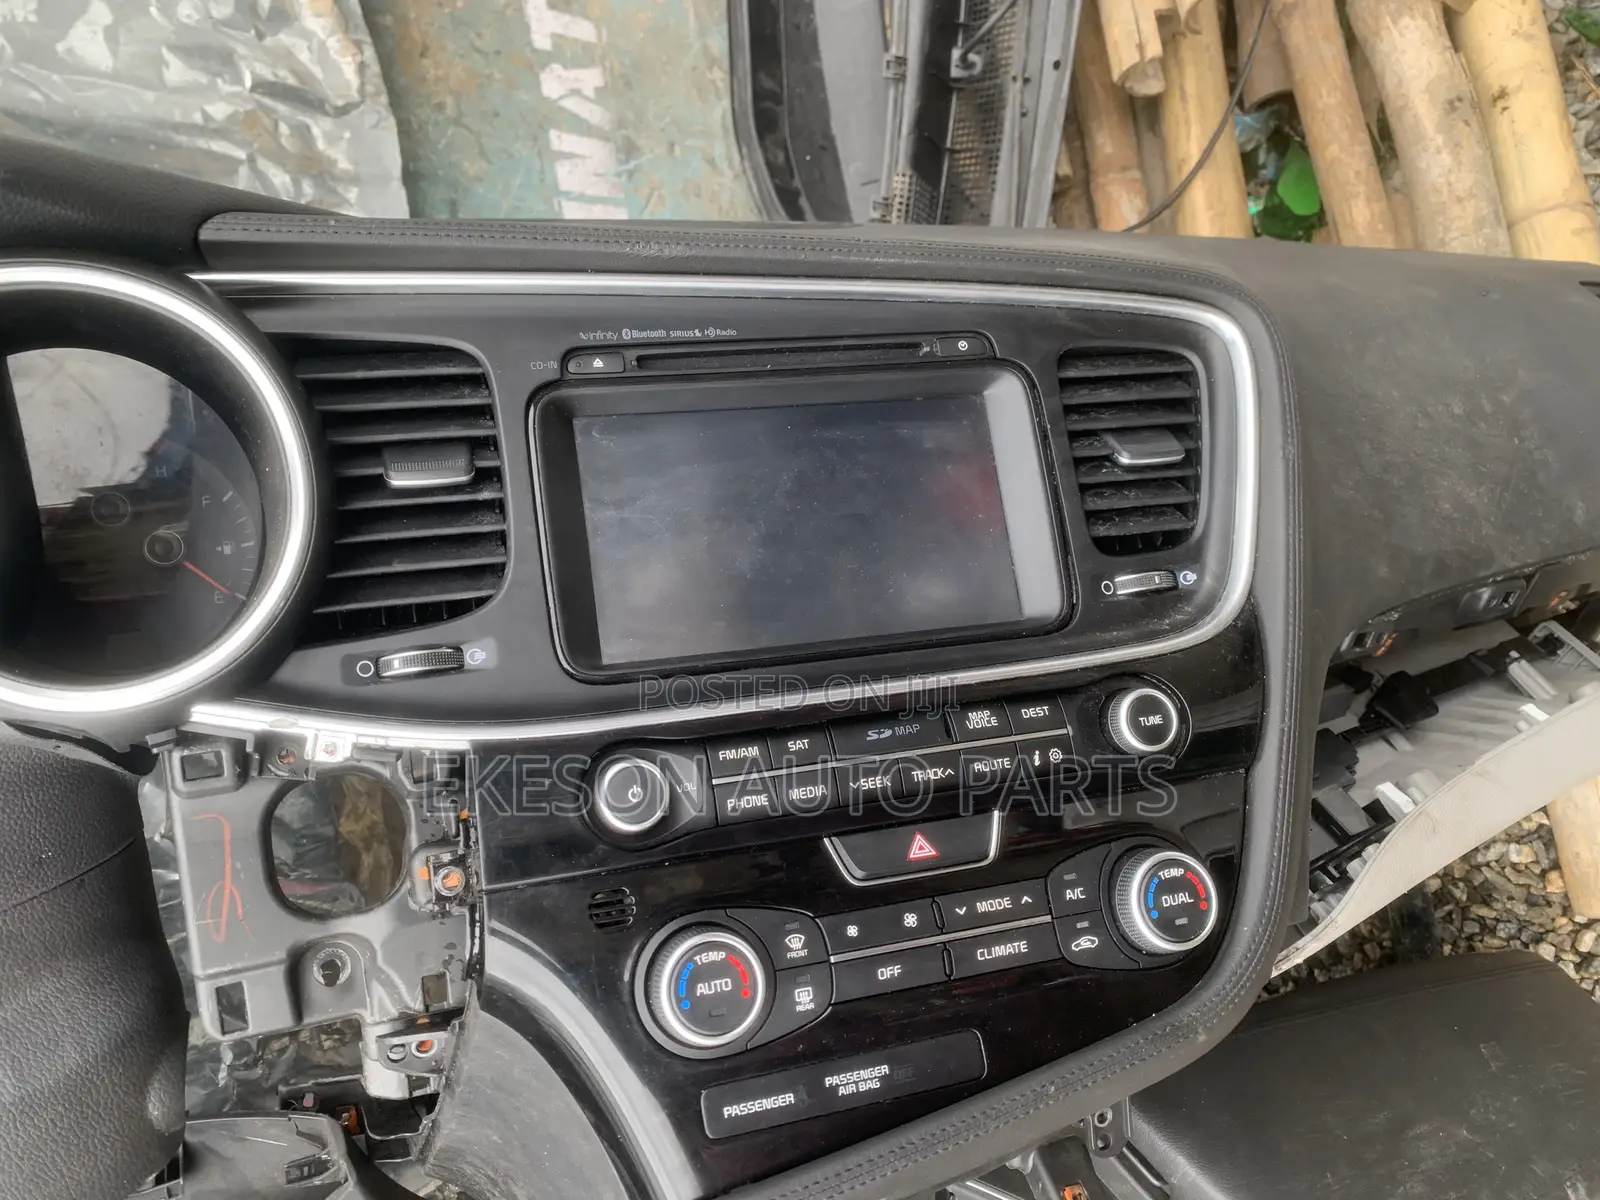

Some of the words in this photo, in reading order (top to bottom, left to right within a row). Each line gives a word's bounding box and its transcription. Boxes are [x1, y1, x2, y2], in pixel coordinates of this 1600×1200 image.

[631, 328, 667, 338] Bluetooth
[716, 328, 738, 336] Radio
[530, 360, 558, 370] CD-IN
[968, 710, 991, 722] MAP
[1021, 705, 1050, 719] DEST
[966, 716, 999, 730] VOICE
[1138, 714, 1164, 727] TUNE
[894, 723, 921, 737] MAP
[787, 738, 810, 752] SAT
[718, 745, 760, 761] FM/AM
[974, 757, 1012, 773] ROUTE
[861, 775, 892, 791] SEEK
[911, 768, 945, 783] TRACK
[676, 782, 698, 793] VOL
[788, 784, 829, 801] MEDIA
[727, 793, 770, 811] PHONE
[1158, 867, 1185, 881] TEMP
[1066, 887, 1086, 901] A/C
[1161, 892, 1194, 908] DUAL
[976, 897, 1013, 914] MODE
[786, 949, 809, 959] FRONT
[976, 940, 1029, 961] CLIMATE
[694, 951, 727, 967] TEMP
[877, 965, 902, 981] OFF
[696, 978, 732, 997] AUTO
[796, 1002, 815, 1013] REAR
[825, 1064, 890, 1088] PASSENGER
[838, 1082, 857, 1097] AIR
[858, 1078, 881, 1092] BAG
[723, 1092, 795, 1119] PASSENGER
